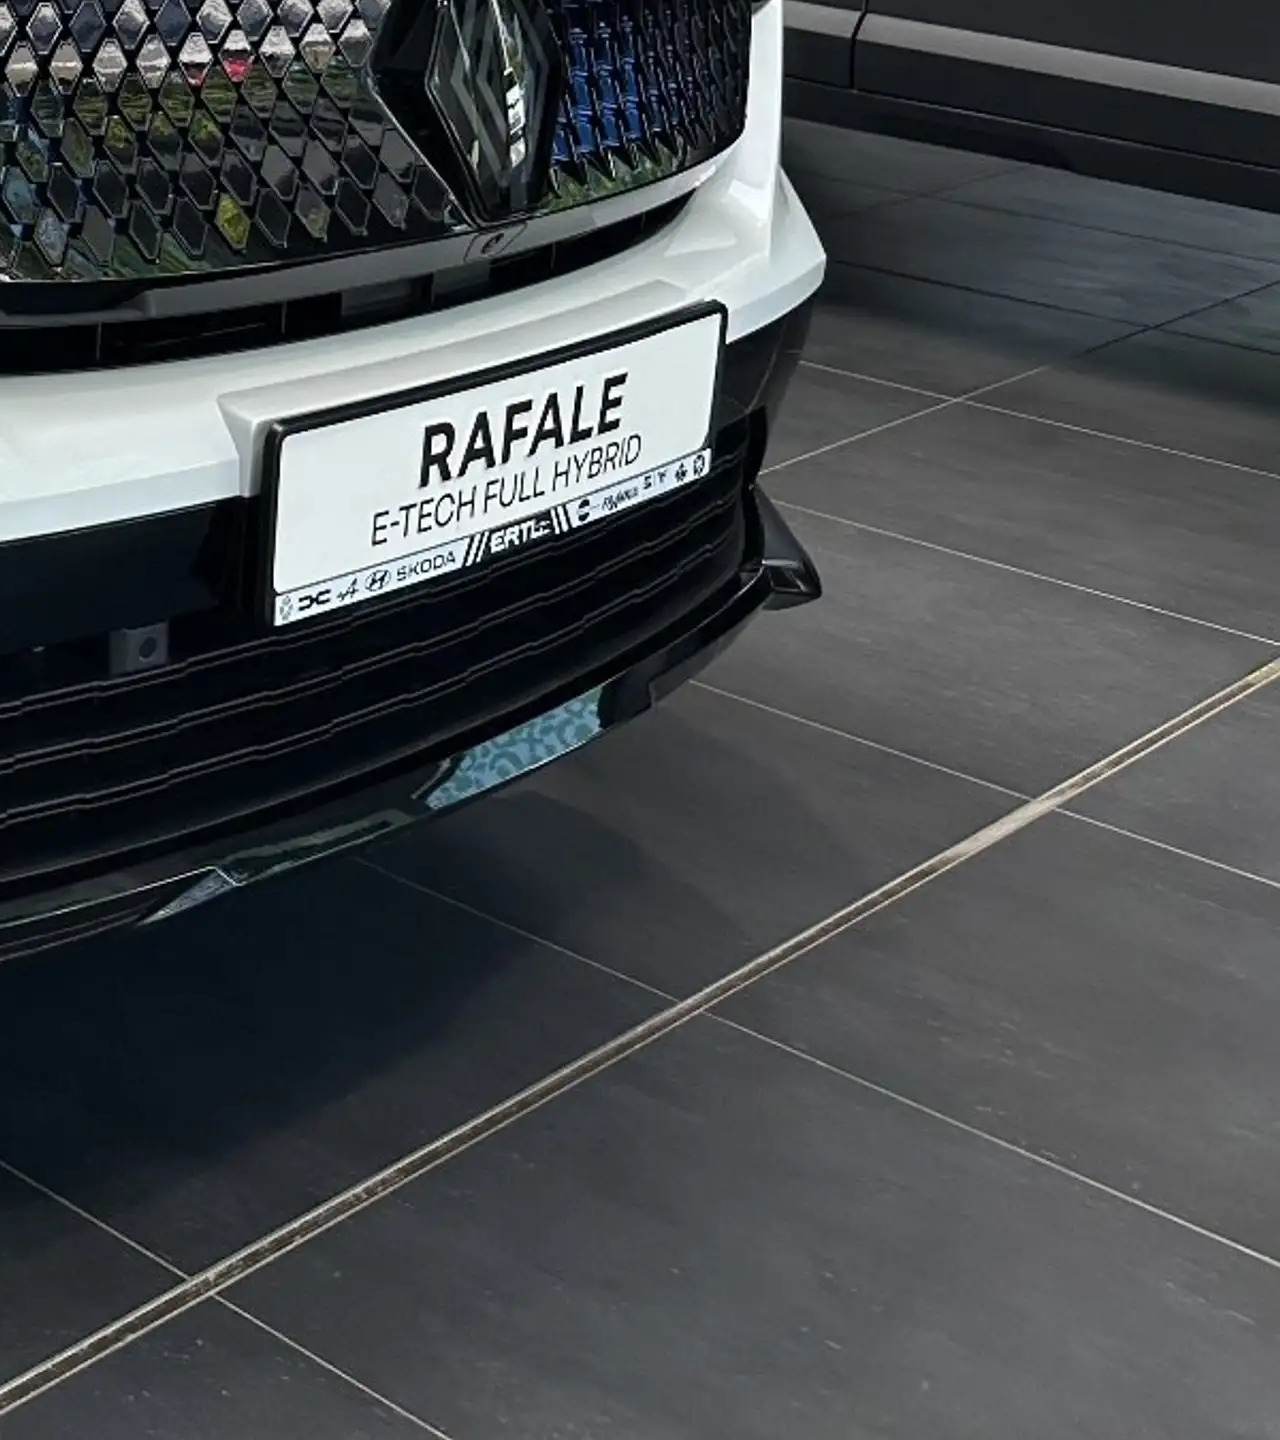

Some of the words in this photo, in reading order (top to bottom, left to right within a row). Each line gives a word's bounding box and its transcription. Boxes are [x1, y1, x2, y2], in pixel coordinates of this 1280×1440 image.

[419, 371, 629, 489] RAFALE
[370, 491, 476, 547] E-TECH
[483, 468, 545, 514] FULL
[551, 434, 643, 492] HYBRID
